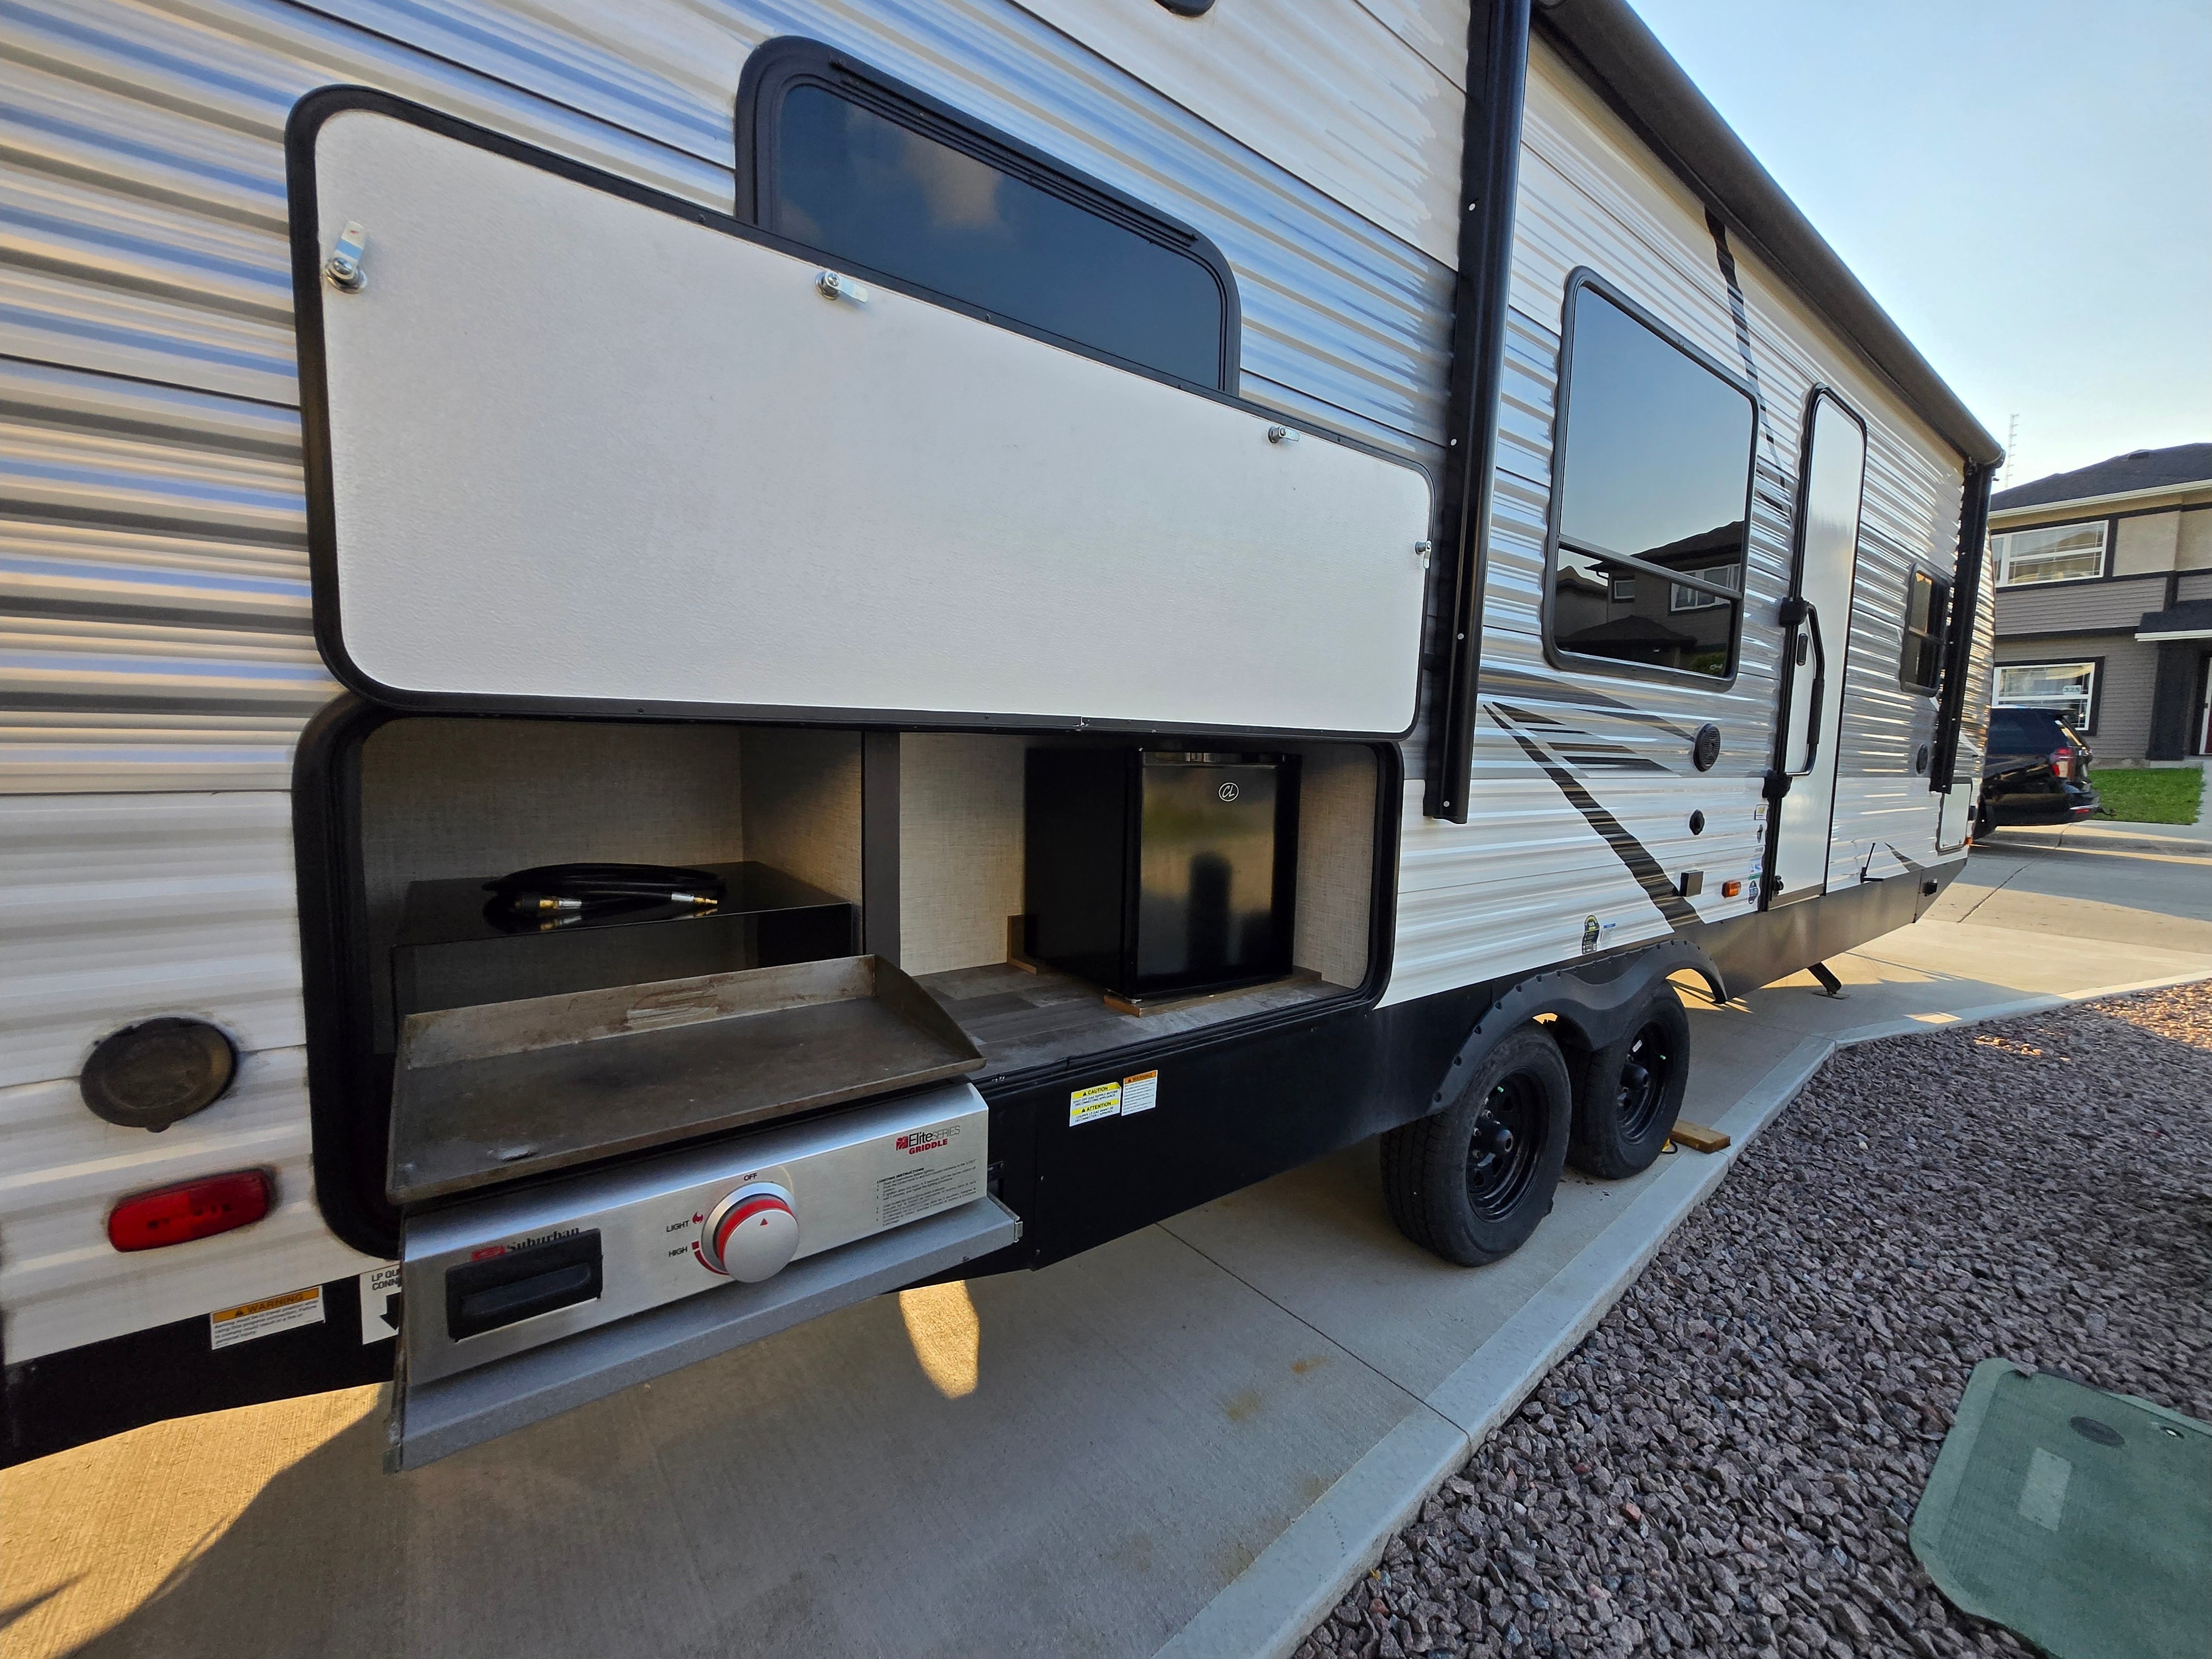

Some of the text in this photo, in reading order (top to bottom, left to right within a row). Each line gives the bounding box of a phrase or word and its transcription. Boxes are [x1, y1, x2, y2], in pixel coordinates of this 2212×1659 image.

[1132, 1072, 1153, 1081] WARNING
[1087, 1086, 1109, 1095] CAUTION
[1086, 1101, 1112, 1112] ATTENTION
[909, 1138, 948, 1155] GRIDDLE
[743, 1172, 758, 1181] OFF
[666, 1220, 690, 1233] LIGHT
[507, 1227, 580, 1251] Suburban
[668, 1246, 688, 1258] HIGH
[371, 1267, 400, 1282] LP QU
[247, 1293, 304, 1313] WARNING
